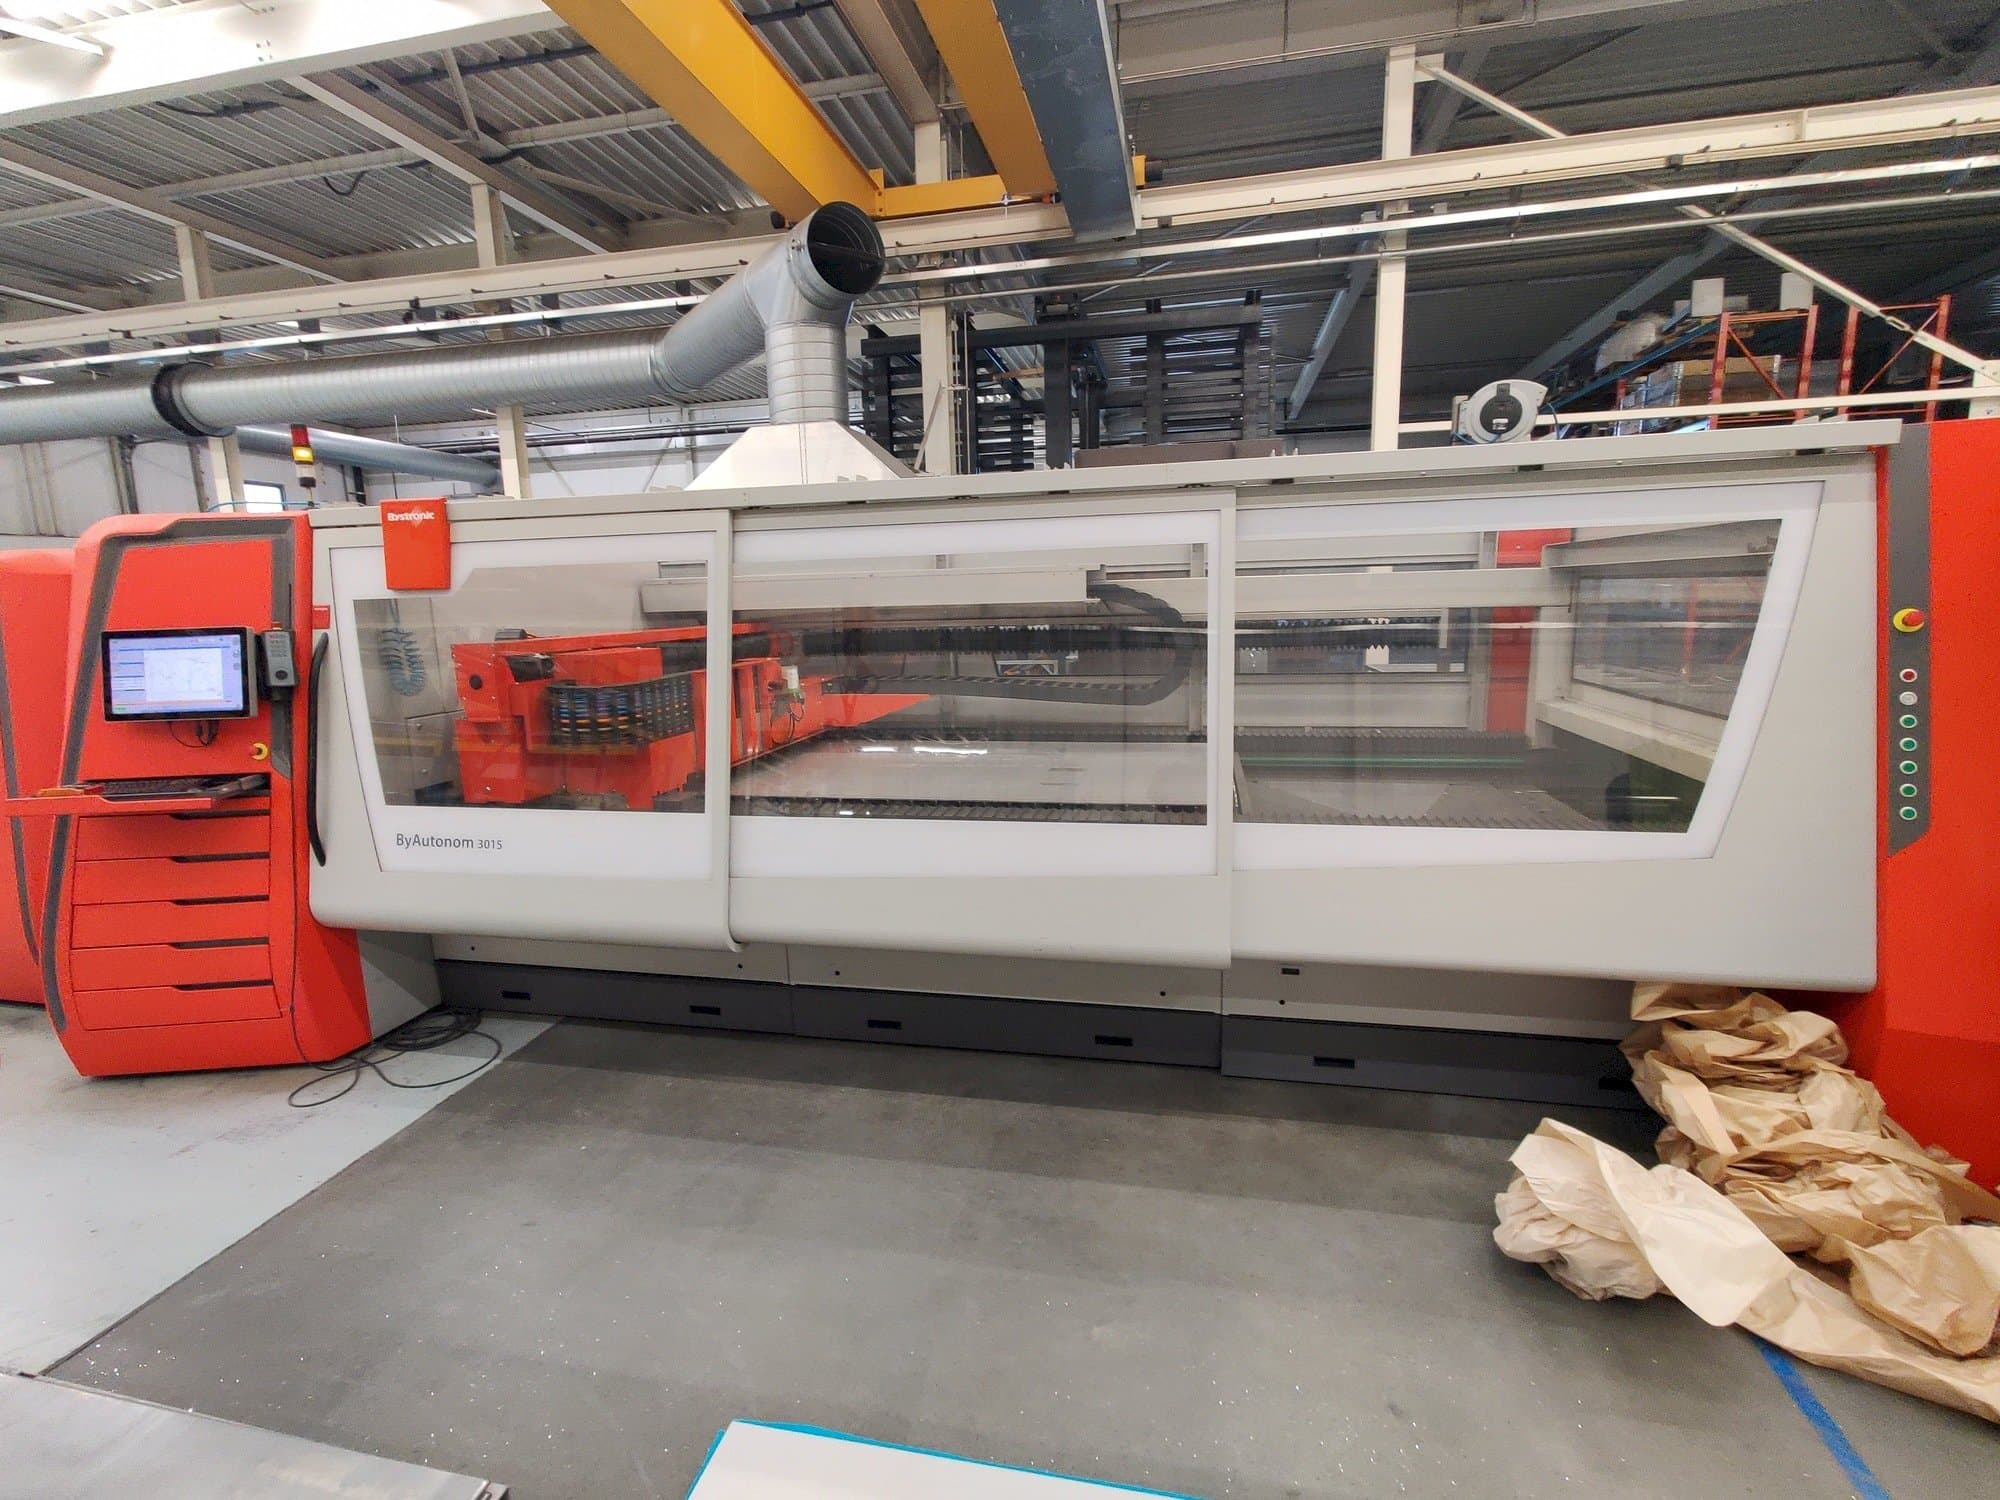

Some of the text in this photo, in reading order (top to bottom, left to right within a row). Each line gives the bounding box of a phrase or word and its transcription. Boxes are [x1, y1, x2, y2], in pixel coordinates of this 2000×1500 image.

[387, 511, 435, 522] Bystronic
[396, 833, 503, 850] ByAutonom 3015
